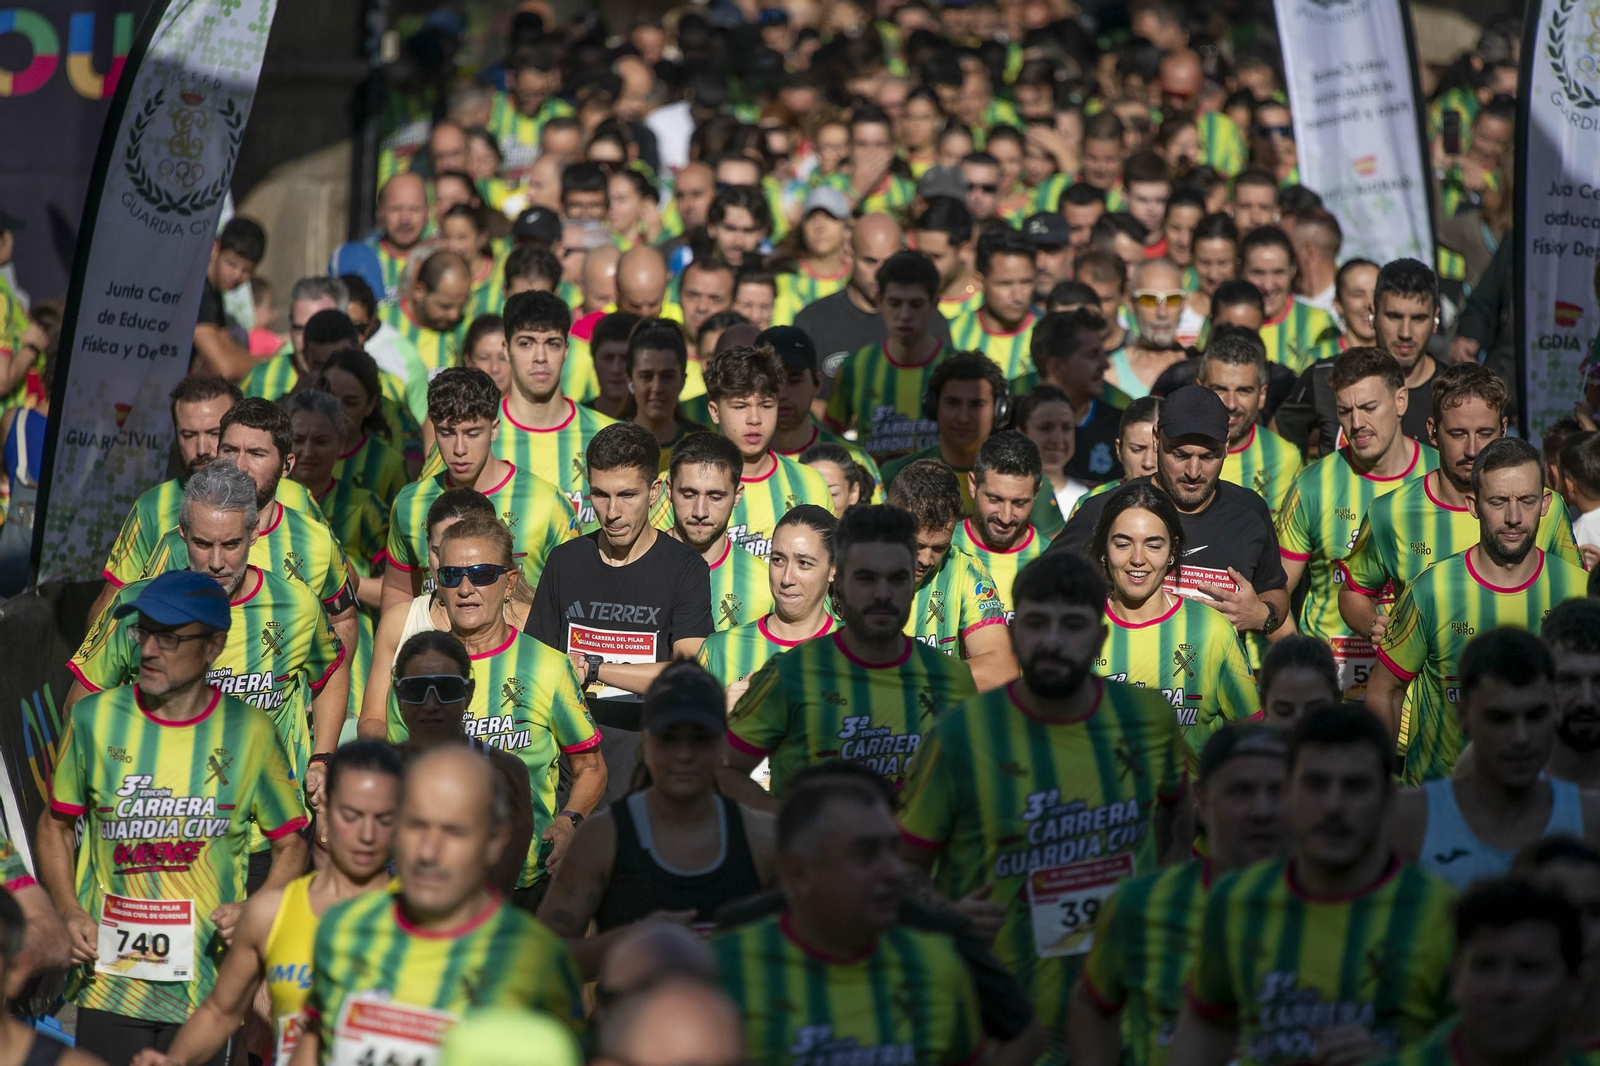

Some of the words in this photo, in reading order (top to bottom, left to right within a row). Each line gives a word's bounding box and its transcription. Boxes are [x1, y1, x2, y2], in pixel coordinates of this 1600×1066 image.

[121, 191, 183, 236] GUARDIA
[105, 280, 144, 300] Junta
[97, 308, 116, 326] de
[119, 311, 171, 333] Educa
[81, 335, 119, 355] Física
[123, 344, 133, 360] y
[1334, 508, 1350, 516] RUN
[1410, 542, 1426, 550] RUN
[589, 601, 661, 626] TERREX
[1451, 621, 1468, 630] RUN
[578, 639, 600, 648] GUARDIA
[591, 634, 616, 642] CARRERA
[206, 667, 232, 678] DICIÓN
[210, 671, 273, 694] RRERA
[465, 714, 514, 737] RERA
[838, 715, 870, 739] 3ª
[1176, 708, 1199, 725] VIL
[841, 734, 921, 760] CARRER
[116, 775, 153, 797] 3ª
[117, 797, 216, 818] CARRERA
[101, 818, 179, 839] GUARDIA
[1027, 797, 1140, 845] CARRERA
[995, 834, 1101, 877] GUARDIA
[116, 929, 170, 958] 740
